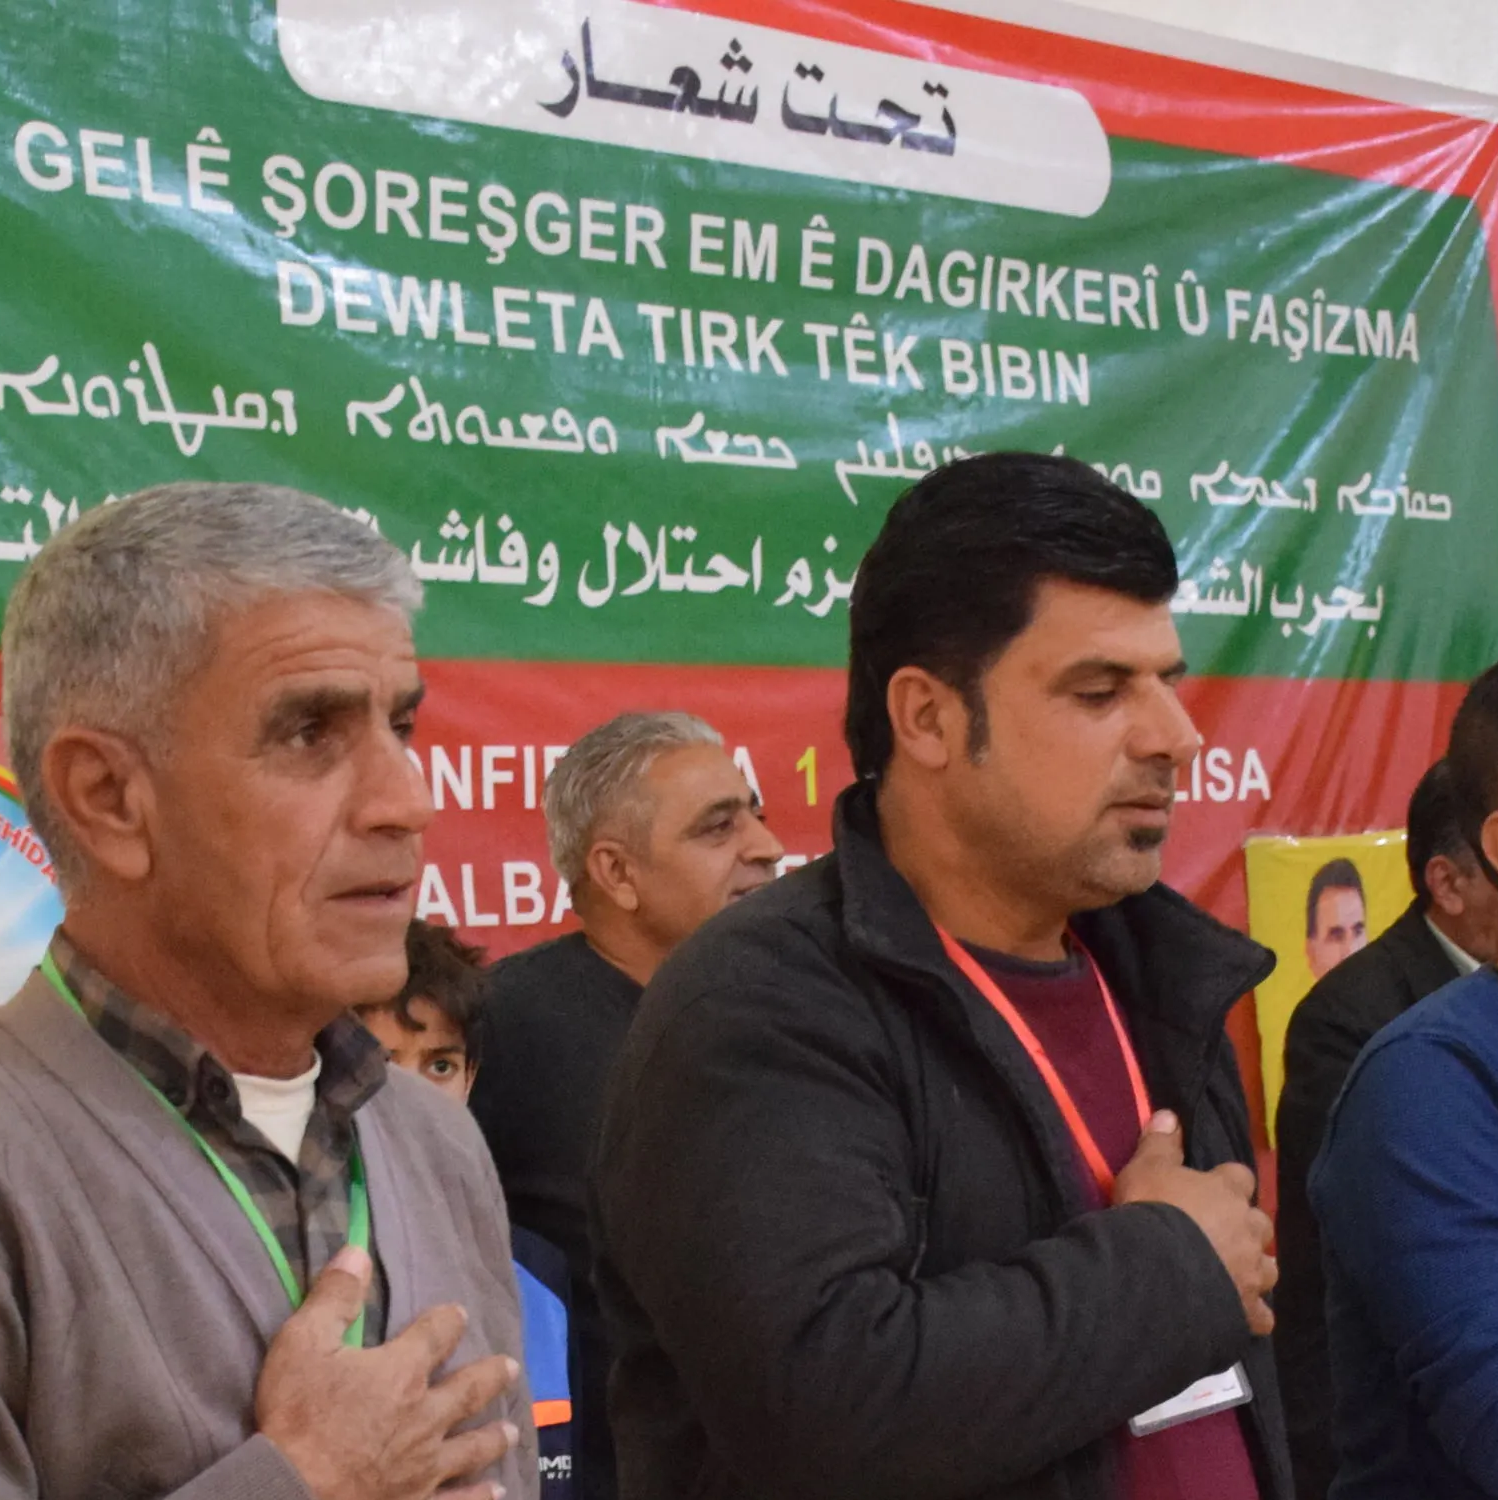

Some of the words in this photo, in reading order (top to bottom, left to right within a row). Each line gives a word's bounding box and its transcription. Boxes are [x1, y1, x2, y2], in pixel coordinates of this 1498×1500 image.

[537, 16, 759, 124] شعار
[782, 62, 957, 156] تحت
[13, 120, 236, 215] GELÊ
[261, 153, 669, 266] ŞOREŞGER
[688, 212, 780, 284] EM
[799, 214, 837, 291] Ê
[855, 236, 1161, 332] DAGIRKERÎ
[1174, 269, 1210, 337] Û
[1223, 287, 1421, 365] FAŞÎZMA
[275, 260, 626, 361] DEWLETA
[635, 302, 790, 378] TIRK
[803, 311, 925, 391] TÊK
[939, 337, 1091, 407] BIBIN
[577, 518, 763, 609] احتلال
[1170, 555, 1263, 617] الشع
[1269, 583, 1385, 641] بحرب
[795, 746, 818, 807] 1
